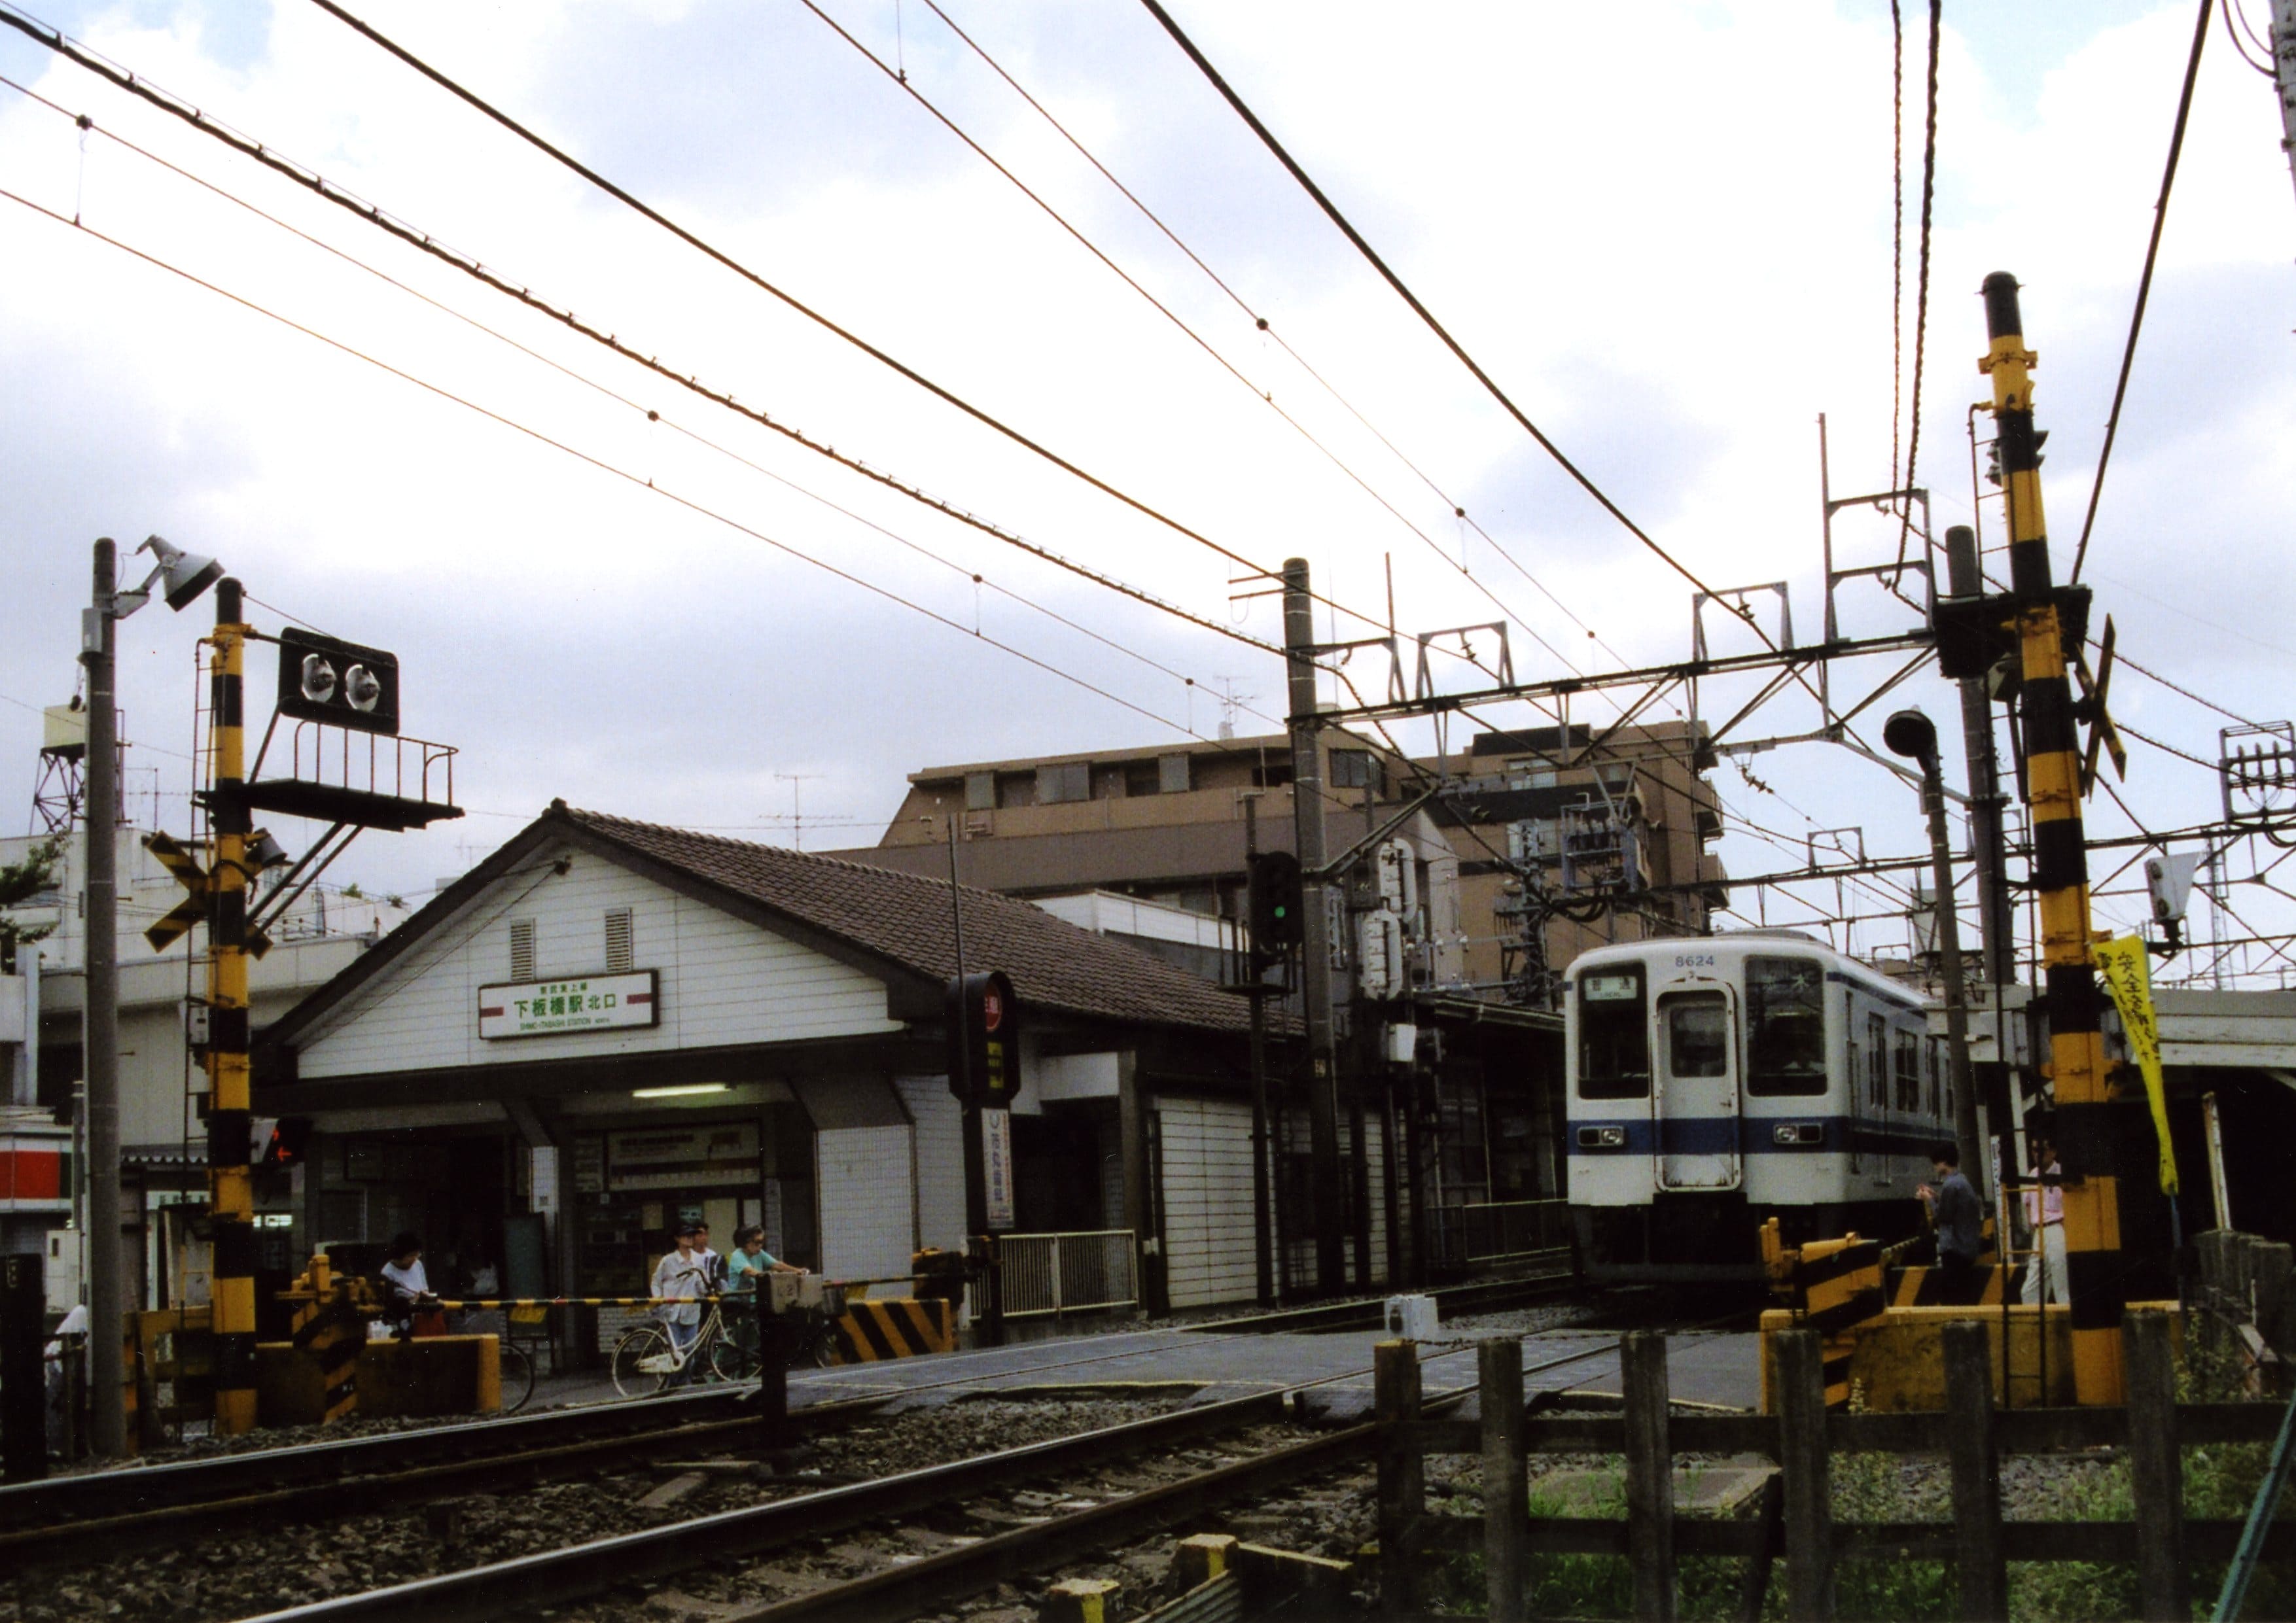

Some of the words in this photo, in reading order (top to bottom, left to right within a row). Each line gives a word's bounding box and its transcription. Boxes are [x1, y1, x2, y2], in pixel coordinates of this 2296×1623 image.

[1674, 955, 1714, 967] 8624
[514, 994, 616, 1018] 下板橋駅北口
